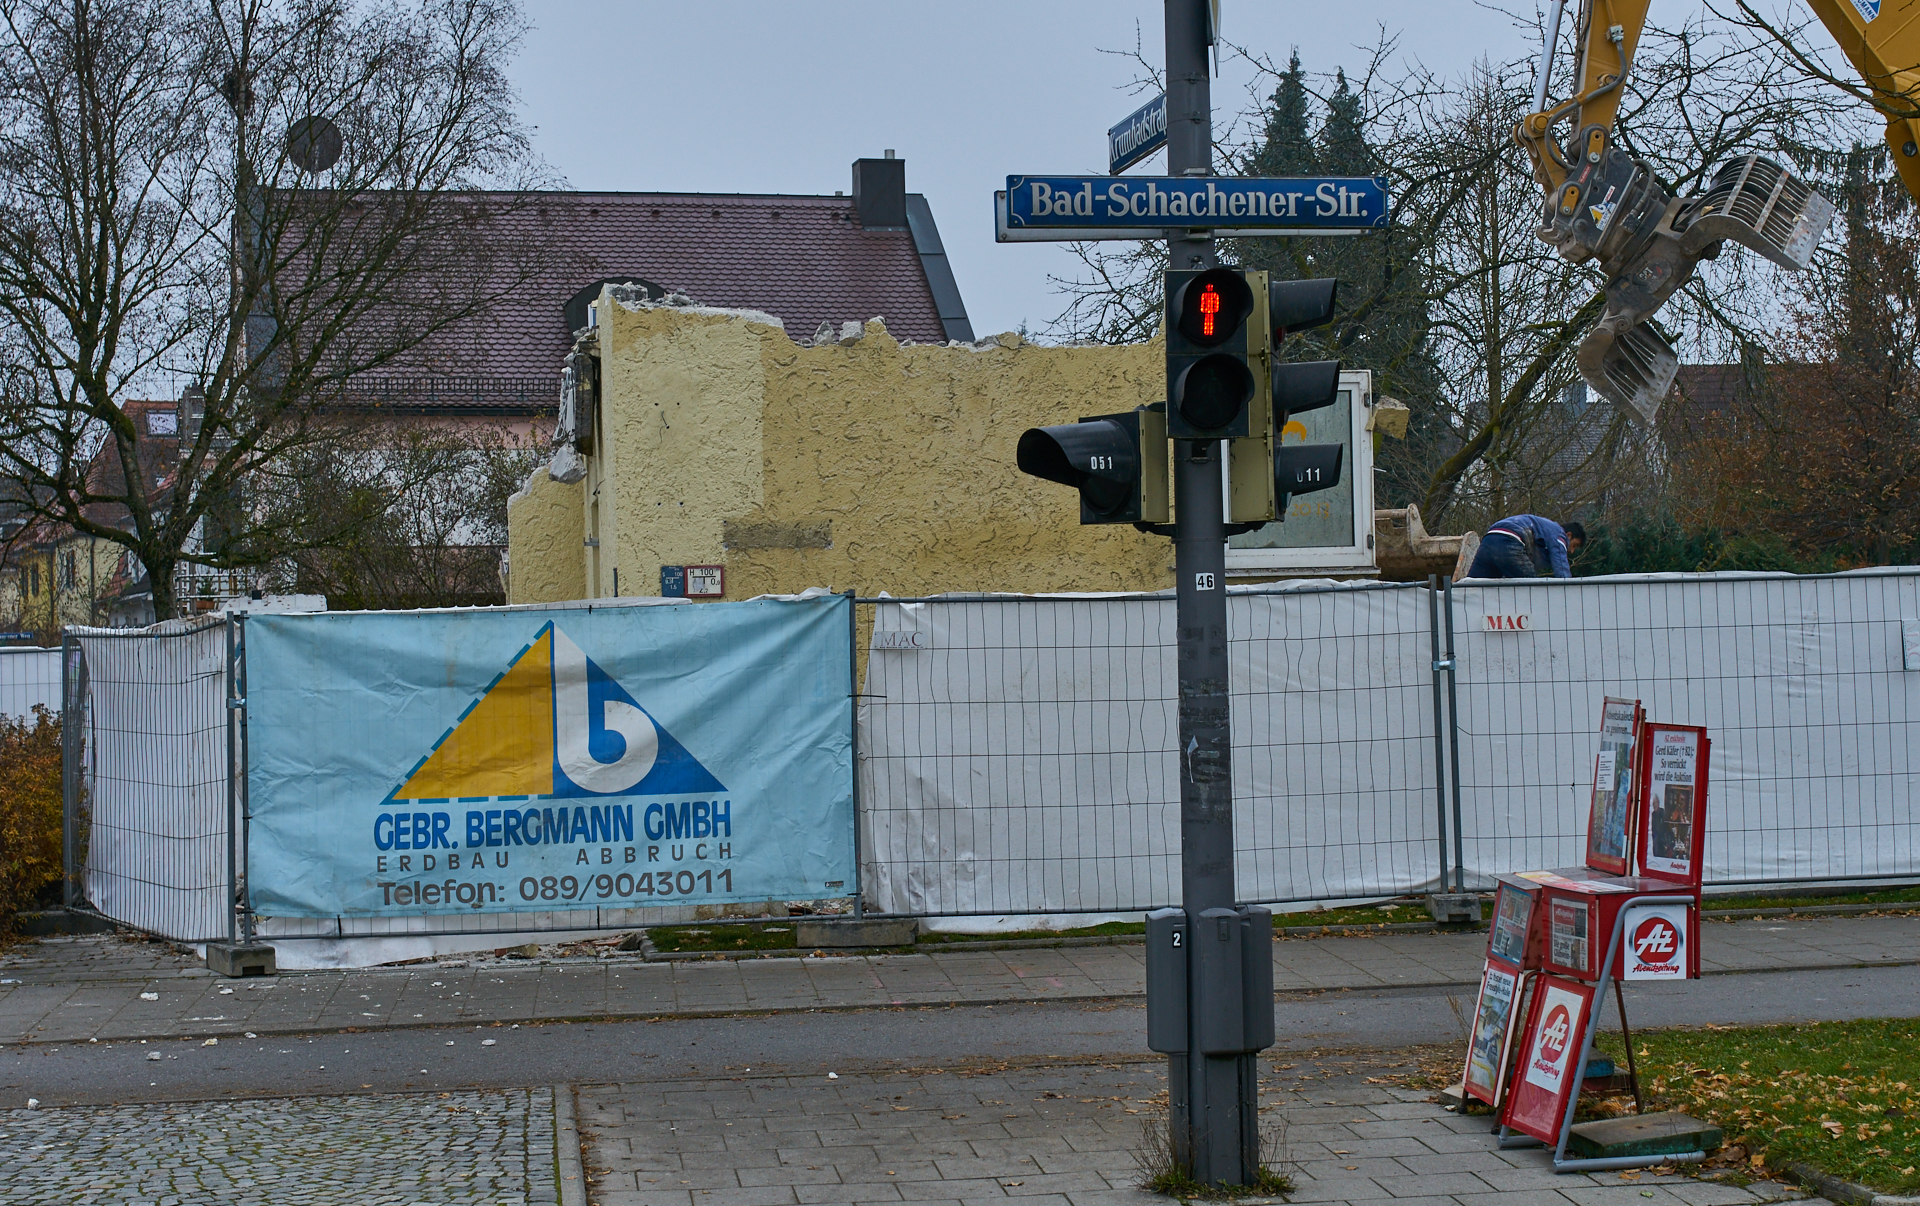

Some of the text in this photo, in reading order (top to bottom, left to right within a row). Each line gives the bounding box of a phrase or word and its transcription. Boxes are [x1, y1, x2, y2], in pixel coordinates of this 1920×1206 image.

[1030, 182, 1368, 218] Bad-Schachener-Str.
[1090, 456, 1112, 470] 051
[700, 568, 714, 576] 100
[1198, 575, 1213, 588] 46
[1486, 614, 1529, 630] MAC
[880, 631, 923, 647] MAC
[1655, 745, 1666, 756] Gerd
[1667, 745, 1679, 756] Käfer
[1661, 758, 1687, 769] So verrückt
[1654, 771, 1665, 781] wird
[1674, 771, 1692, 783] Auktion
[374, 800, 732, 851] GEBR. BERGMANN GMBH
[377, 842, 732, 873] ERDBAU ABBRUCH
[377, 868, 733, 906] Telefon: 089/9043011
[1173, 932, 1181, 947] 2
[1634, 923, 1674, 956] AZ
[1632, 963, 1680, 975] Abendzeitung
[1539, 1013, 1568, 1052] AZ
